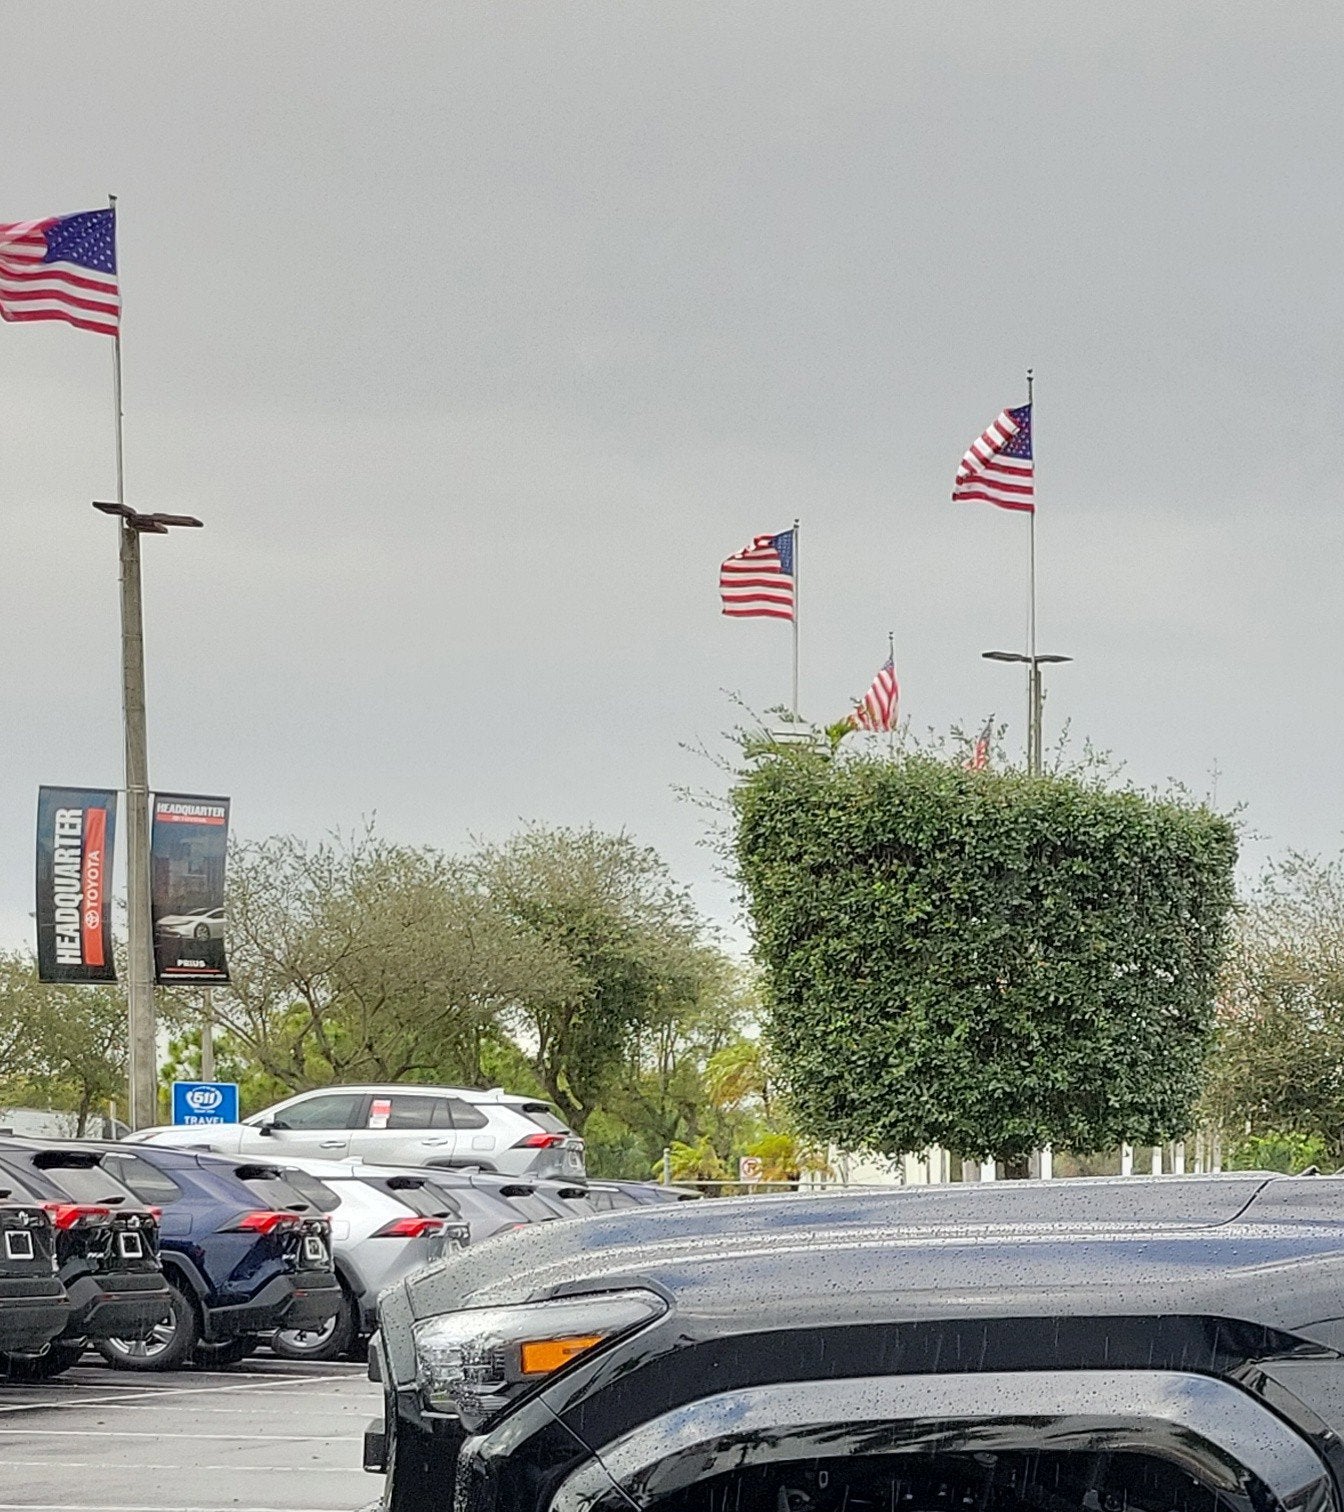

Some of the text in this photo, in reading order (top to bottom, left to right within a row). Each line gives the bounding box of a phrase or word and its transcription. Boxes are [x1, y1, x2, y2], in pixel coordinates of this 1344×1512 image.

[156, 802, 226, 818] HEADQUARTER
[54, 807, 84, 965] HEADQUARTER
[86, 850, 101, 909] TOYOTA
